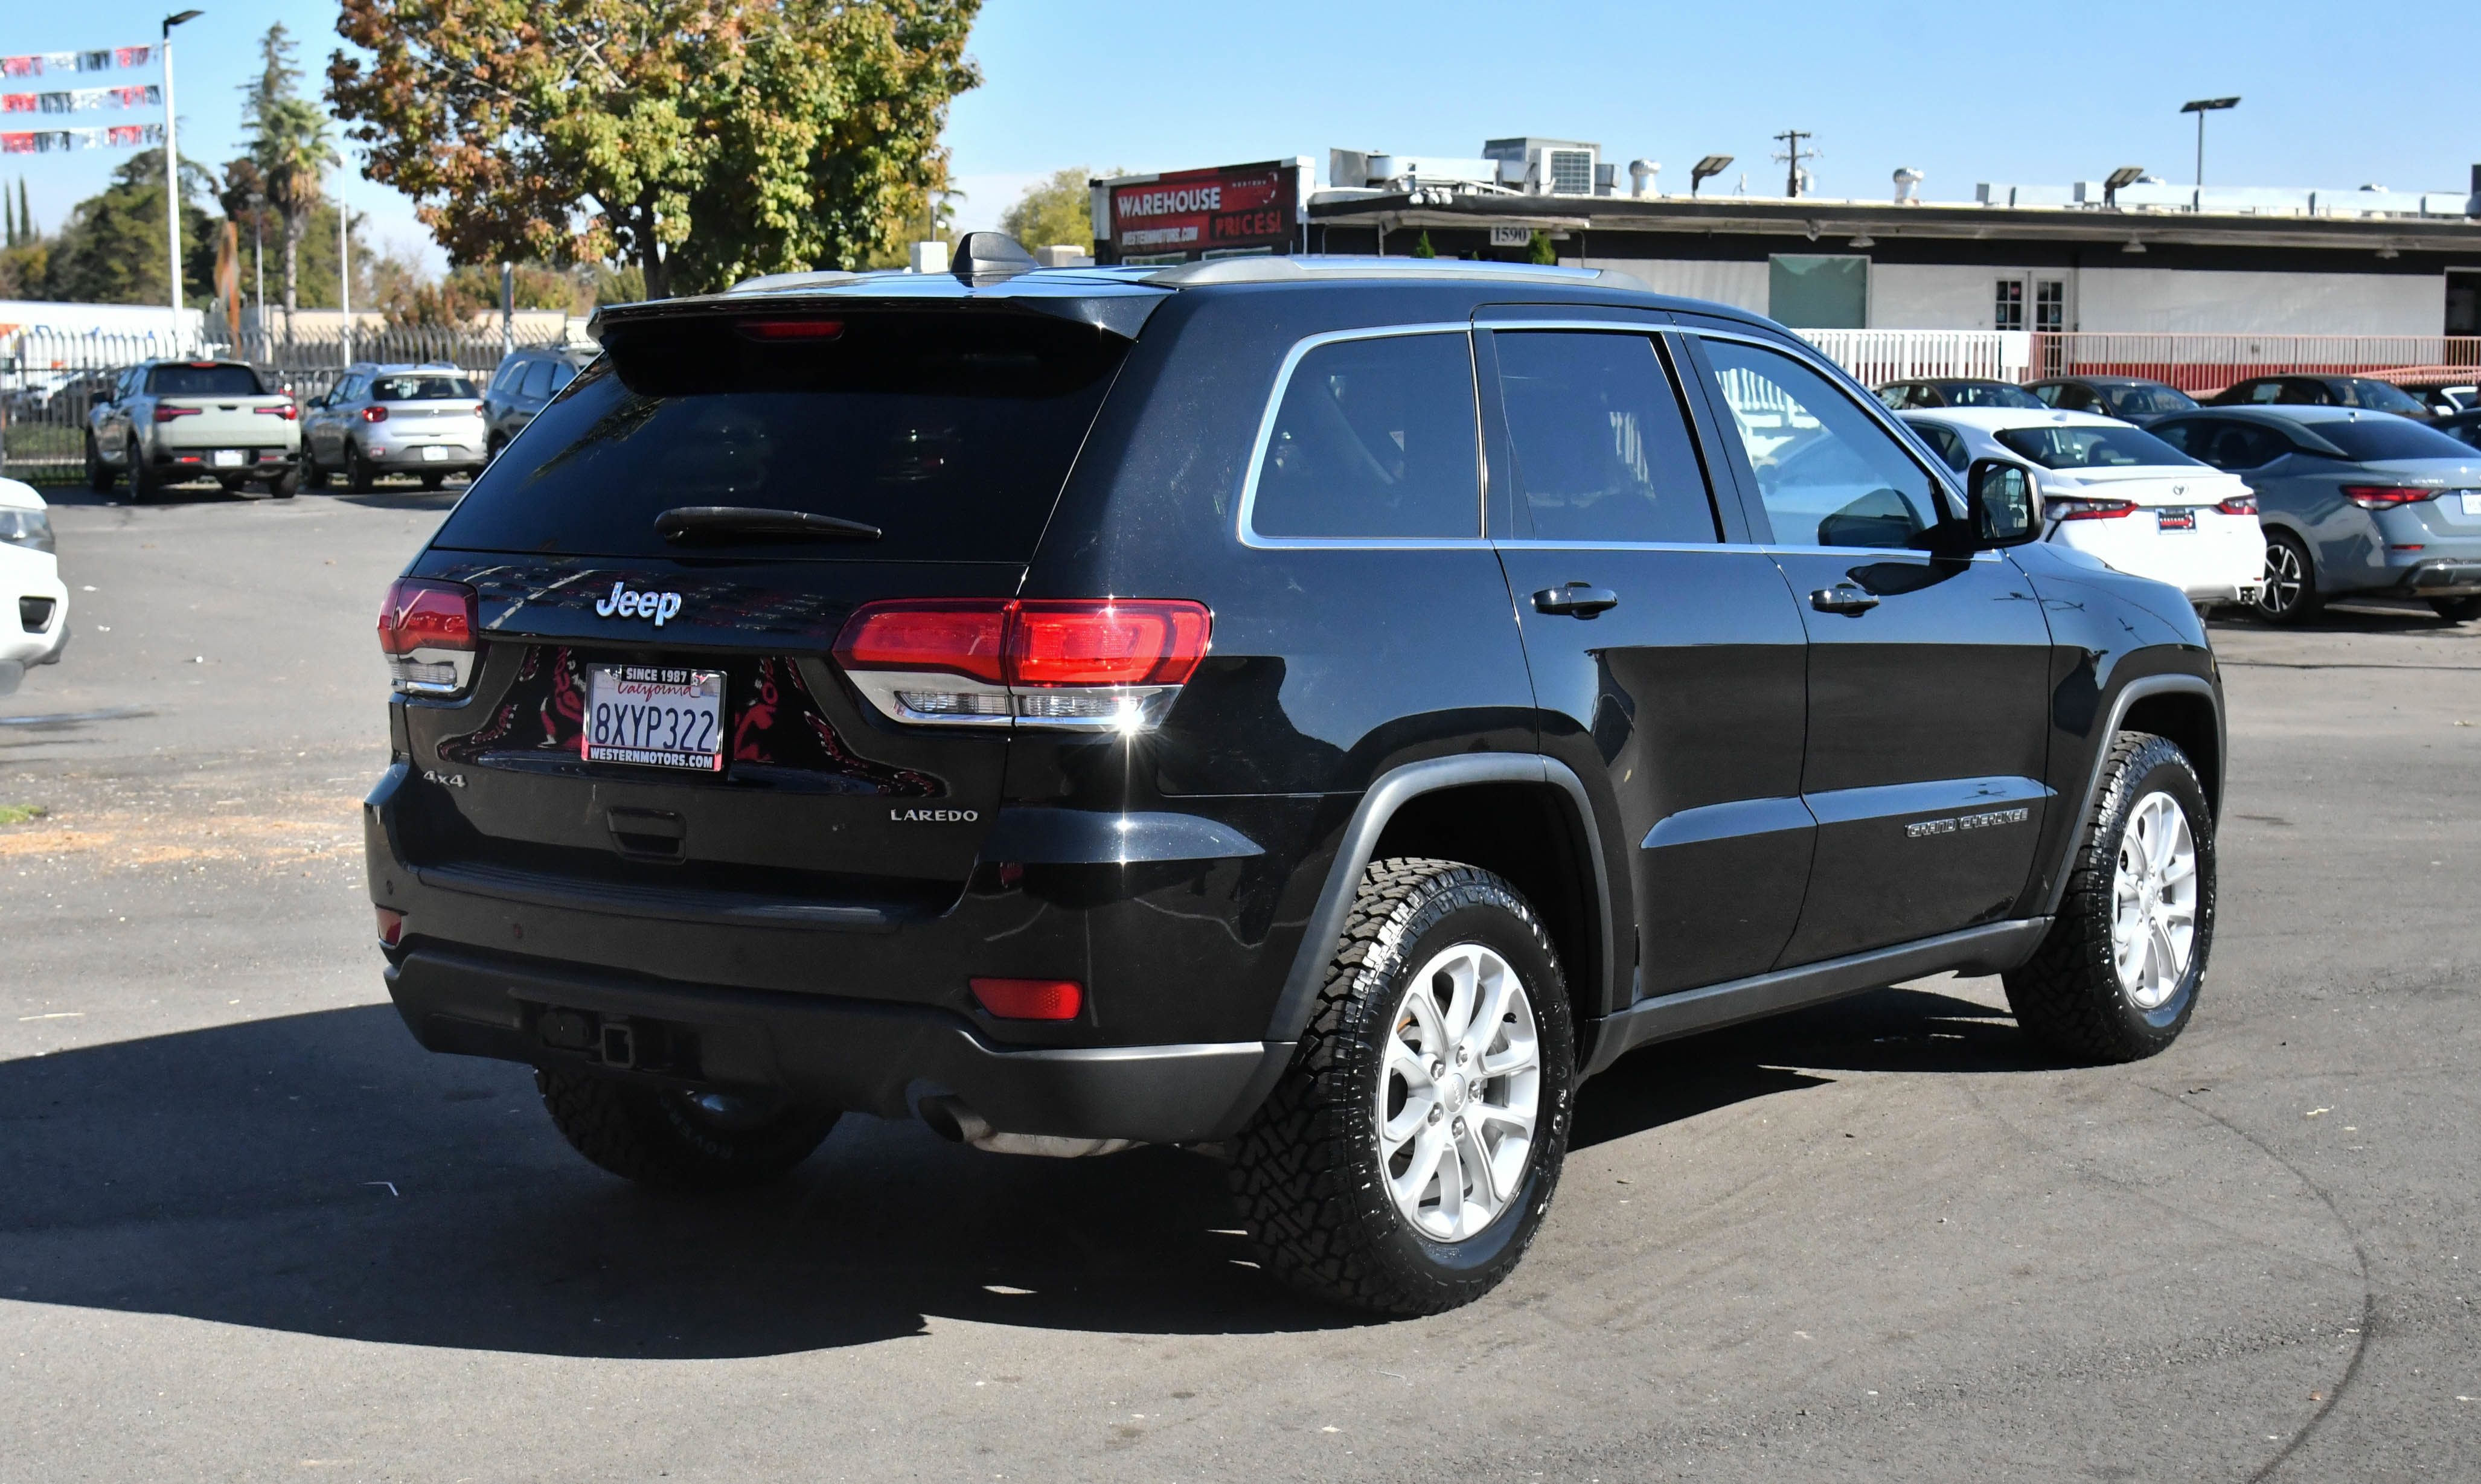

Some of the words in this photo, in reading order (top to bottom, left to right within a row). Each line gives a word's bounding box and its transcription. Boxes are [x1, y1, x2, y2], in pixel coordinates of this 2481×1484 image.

[1117, 186, 1221, 218] WAREHOUSE
[1215, 209, 1281, 237] PRICES!
[1495, 227, 1527, 242] 1590
[595, 581, 682, 627] Jeep
[626, 667, 658, 682] SINCE
[661, 669, 687, 683] 1987
[617, 682, 700, 702] California
[594, 702, 715, 752] 8XYP322
[589, 746, 713, 769] WESTERNMOTORS.COM
[423, 770, 466, 788] 4x4
[890, 808, 979, 822] LAREDO
[1906, 818, 1957, 837] GRAND
[1959, 807, 2029, 830] CHEROKEE
